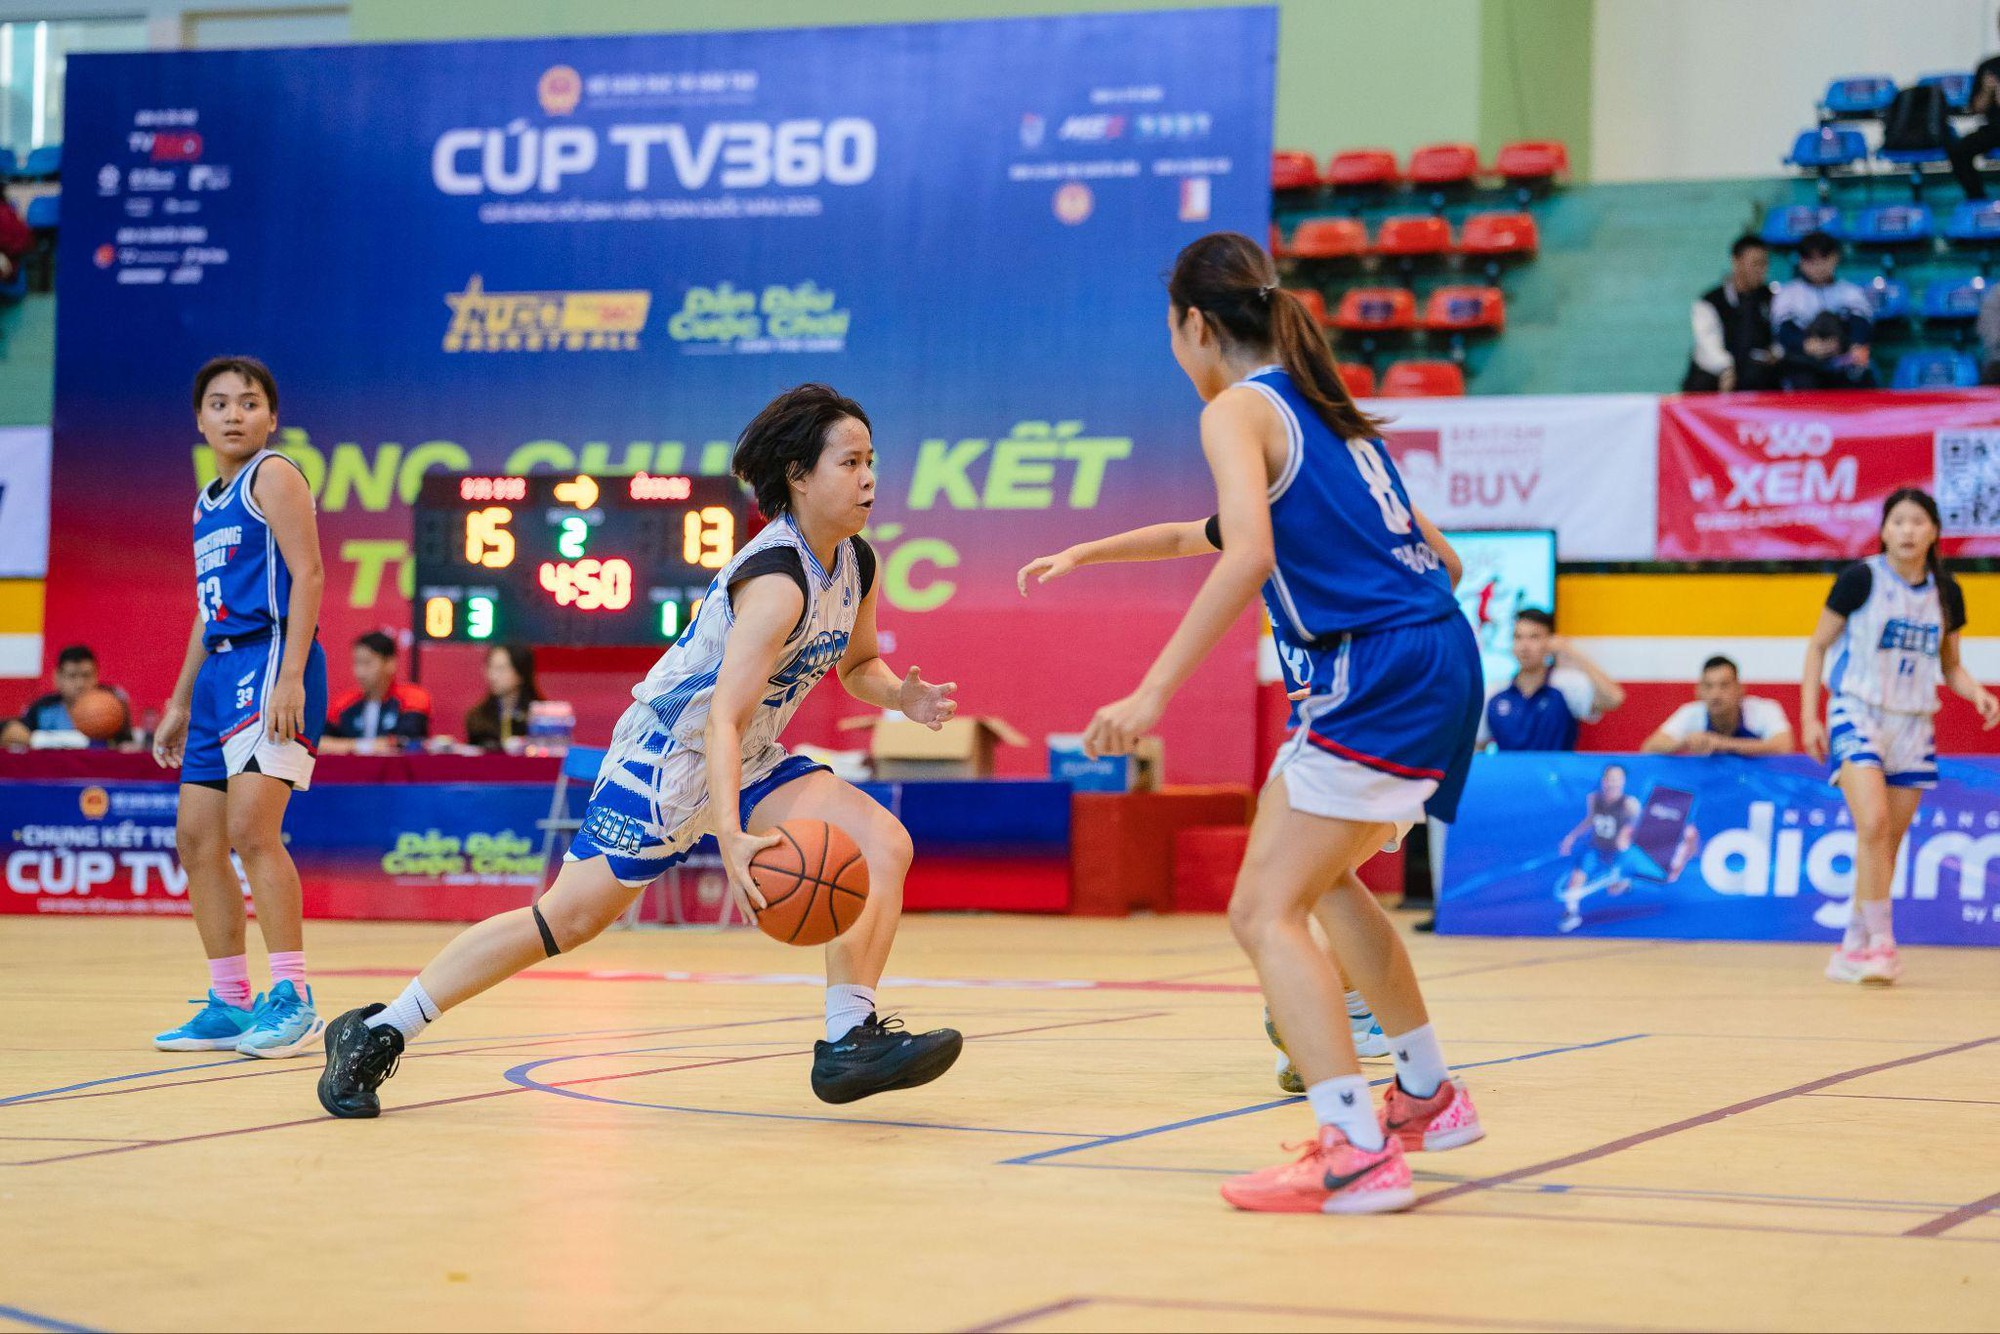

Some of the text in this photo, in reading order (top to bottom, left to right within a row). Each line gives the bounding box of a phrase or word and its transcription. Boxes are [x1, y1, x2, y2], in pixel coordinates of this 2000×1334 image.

[431, 117, 878, 195] CÚP TV360
[906, 418, 1134, 511] KẾT
[1346, 437, 1412, 535] 8
[1449, 471, 1541, 507] BUV
[1723, 455, 1858, 508] XEM
[466, 507, 735, 568] 15 2 13
[425, 597, 453, 638] 0
[467, 597, 494, 638] 3
[236, 686, 254, 710] 33
[22, 825, 99, 847] CHUNG
[101, 818, 147, 848] KẾT
[6, 846, 115, 894] CÚP
